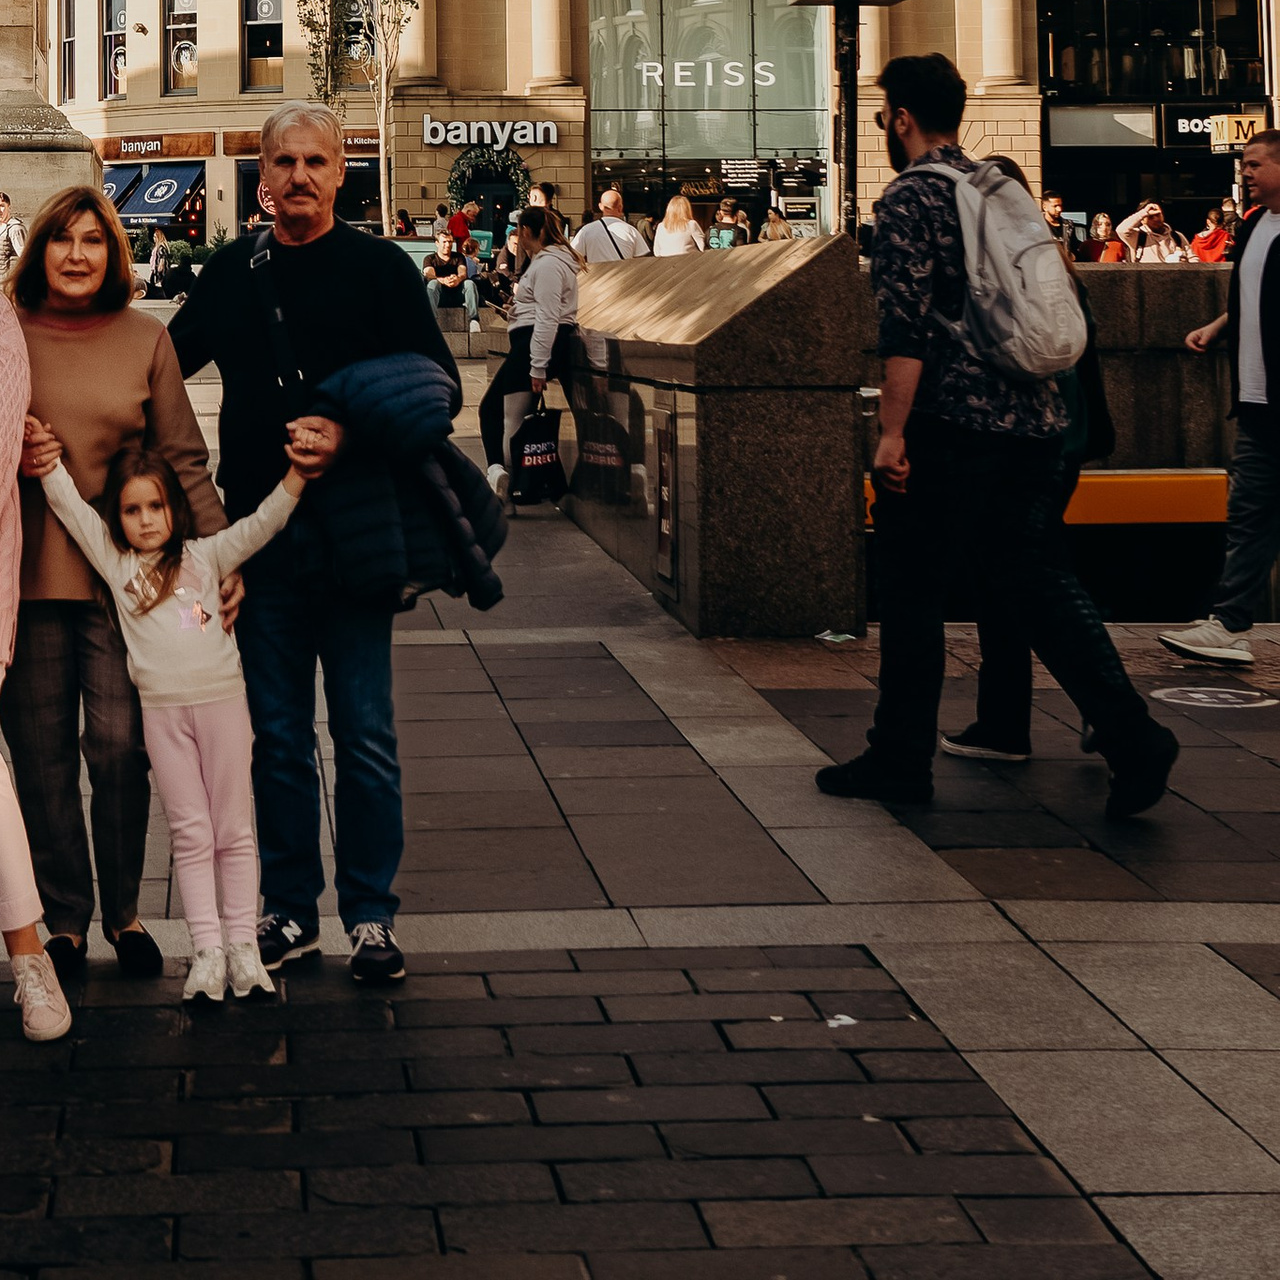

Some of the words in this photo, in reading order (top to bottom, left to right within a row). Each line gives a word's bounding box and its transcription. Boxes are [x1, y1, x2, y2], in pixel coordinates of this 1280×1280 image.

[642, 61, 776, 87] REISS
[423, 113, 558, 151] banyan
[1177, 118, 1211, 133] BOS
[1234, 120, 1256, 140] M
[121, 140, 161, 154] banyan
[353, 137, 380, 145] Kitchen
[524, 453, 556, 466] DIRECT
